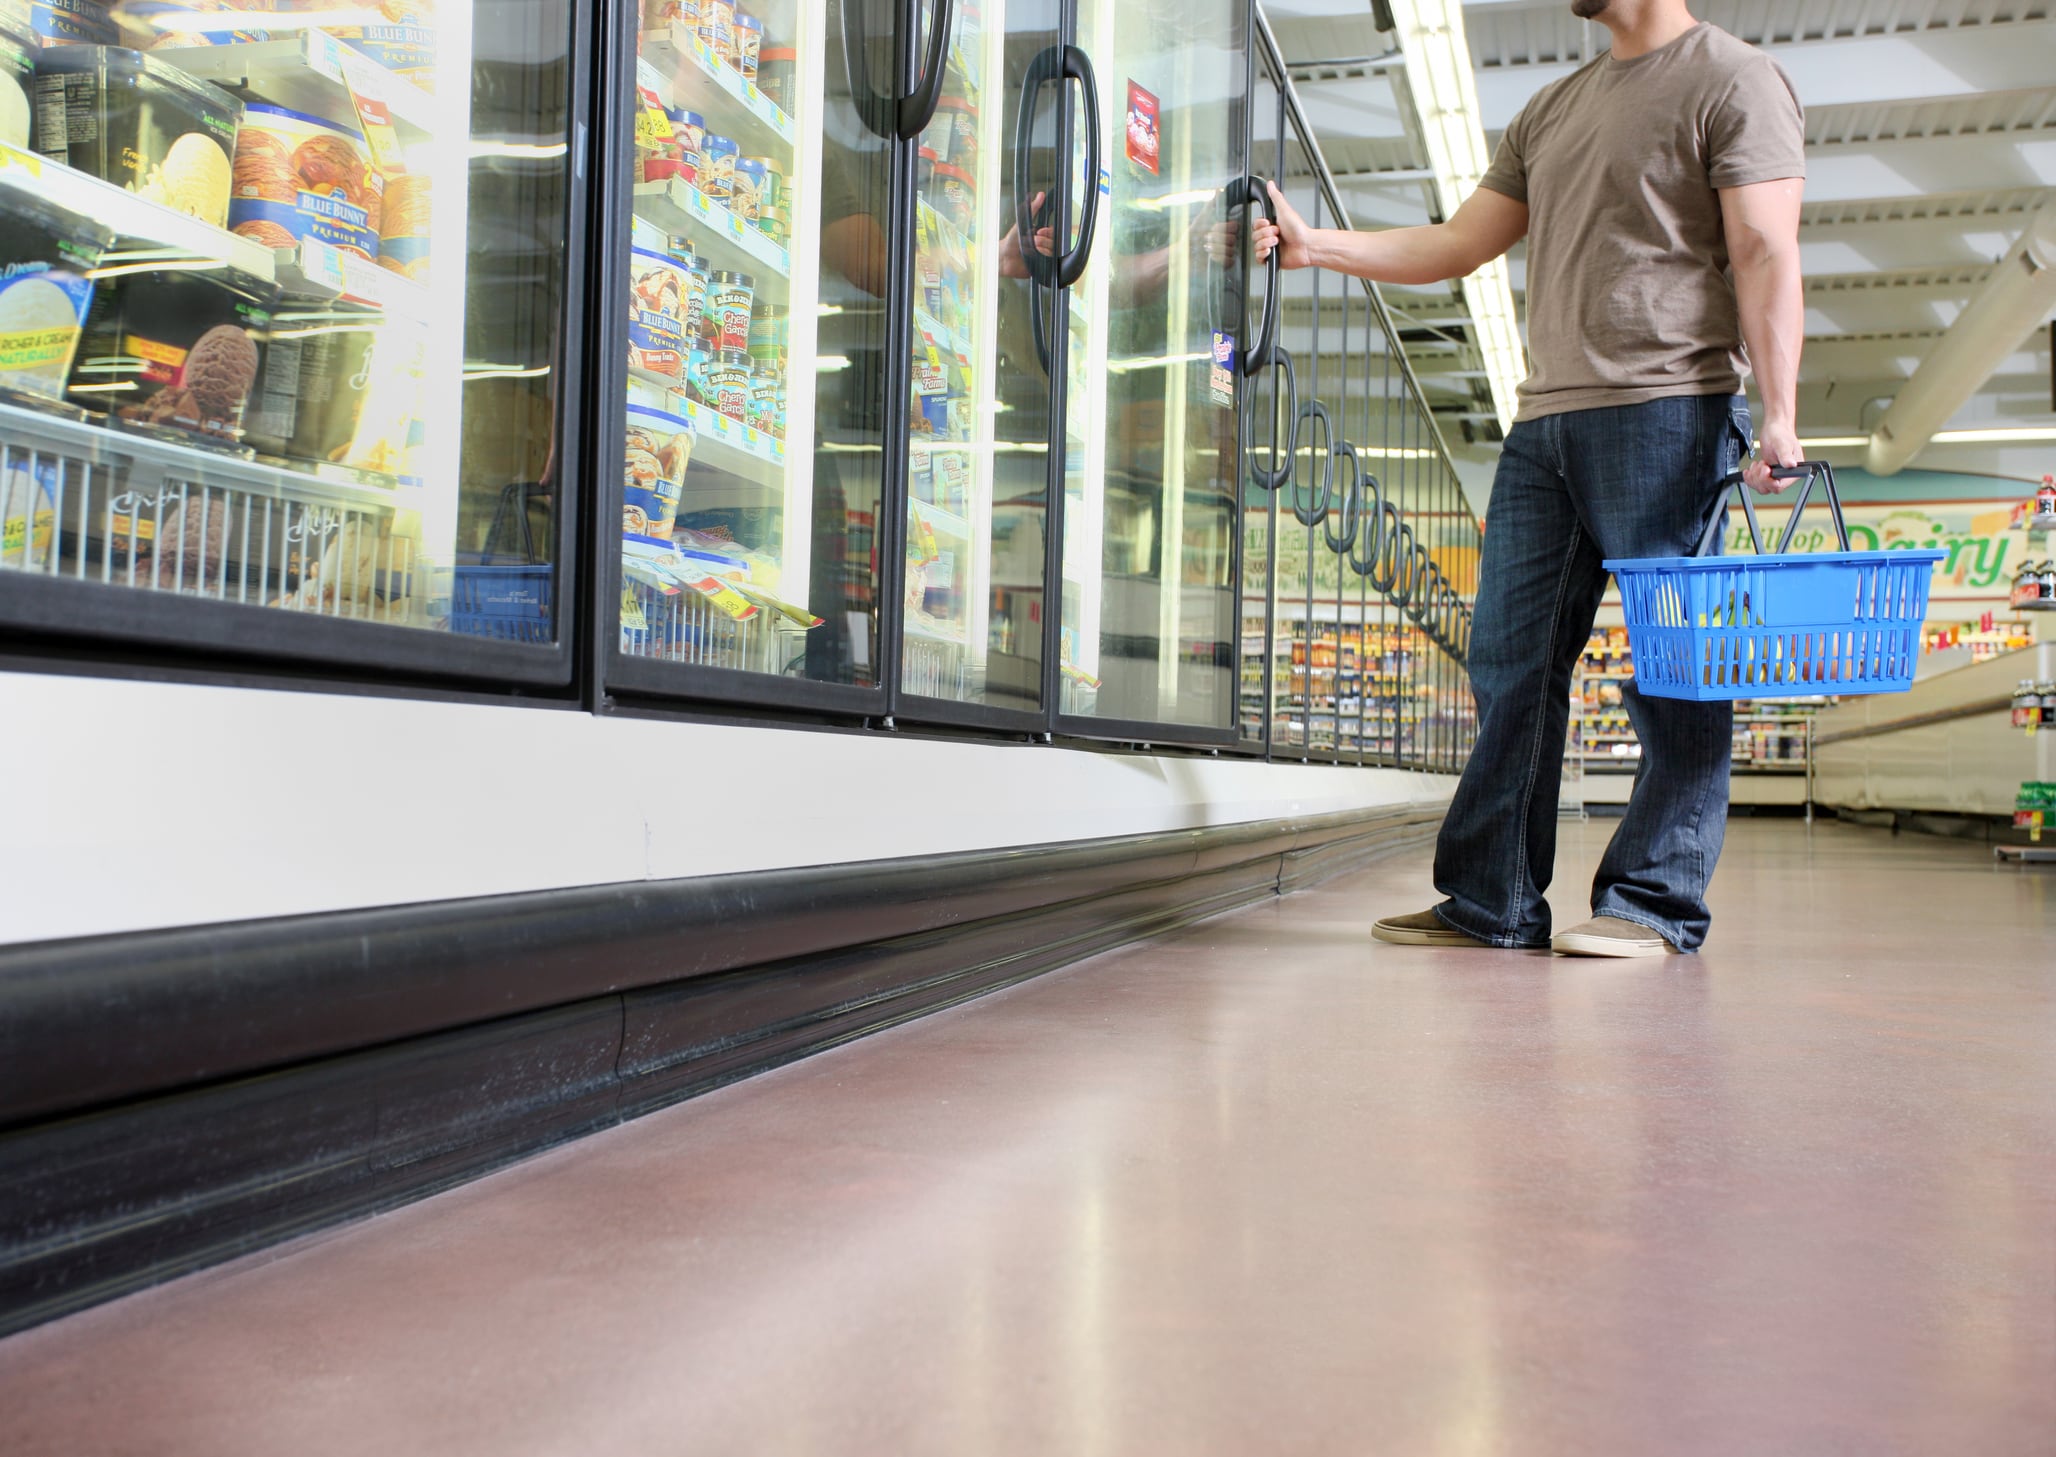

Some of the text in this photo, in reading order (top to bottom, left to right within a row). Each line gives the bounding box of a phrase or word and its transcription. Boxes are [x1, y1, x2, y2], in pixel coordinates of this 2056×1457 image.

[369, 26, 402, 41] BLUE
[302, 195, 365, 227] BLUE BUNNY
[312, 224, 357, 244] PREMIUM
[643, 312, 662, 329] BLUE
[662, 316, 681, 334] BUNNY
[711, 374, 728, 383] BEN
